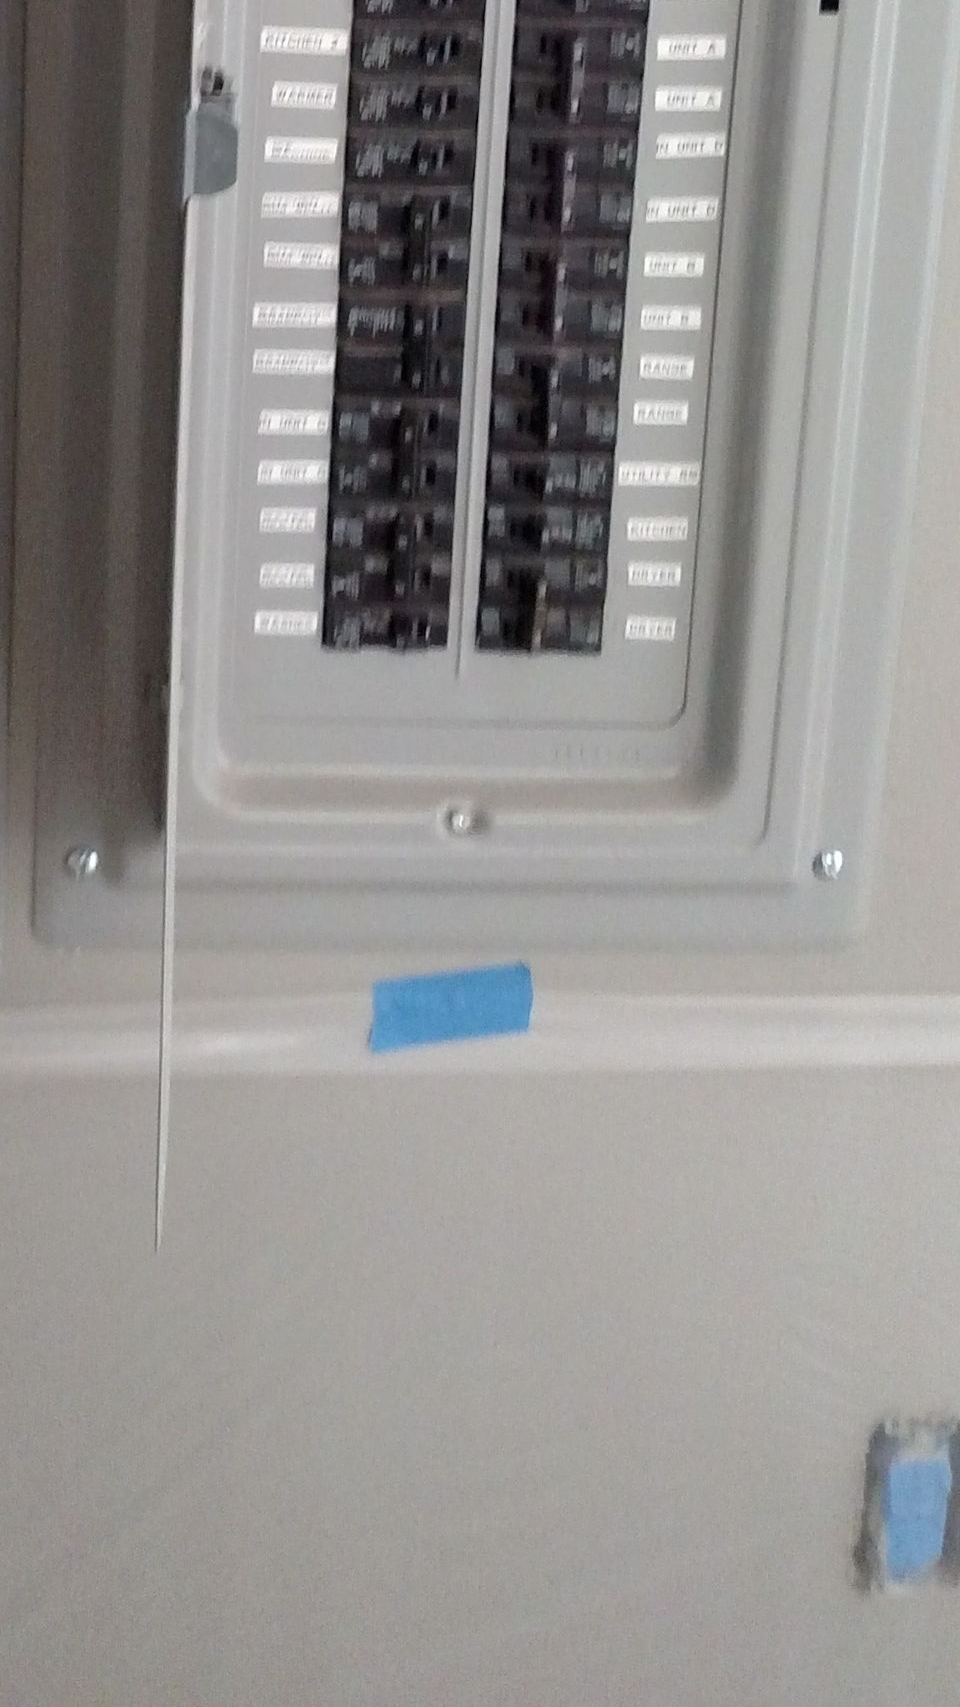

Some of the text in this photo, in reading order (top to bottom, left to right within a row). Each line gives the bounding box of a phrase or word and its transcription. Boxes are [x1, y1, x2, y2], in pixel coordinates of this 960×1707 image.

[669, 44, 696, 55] UNIT
[667, 95, 695, 108] UNIT
[677, 142, 703, 154] UNIT
[668, 206, 696, 217] UNIT
